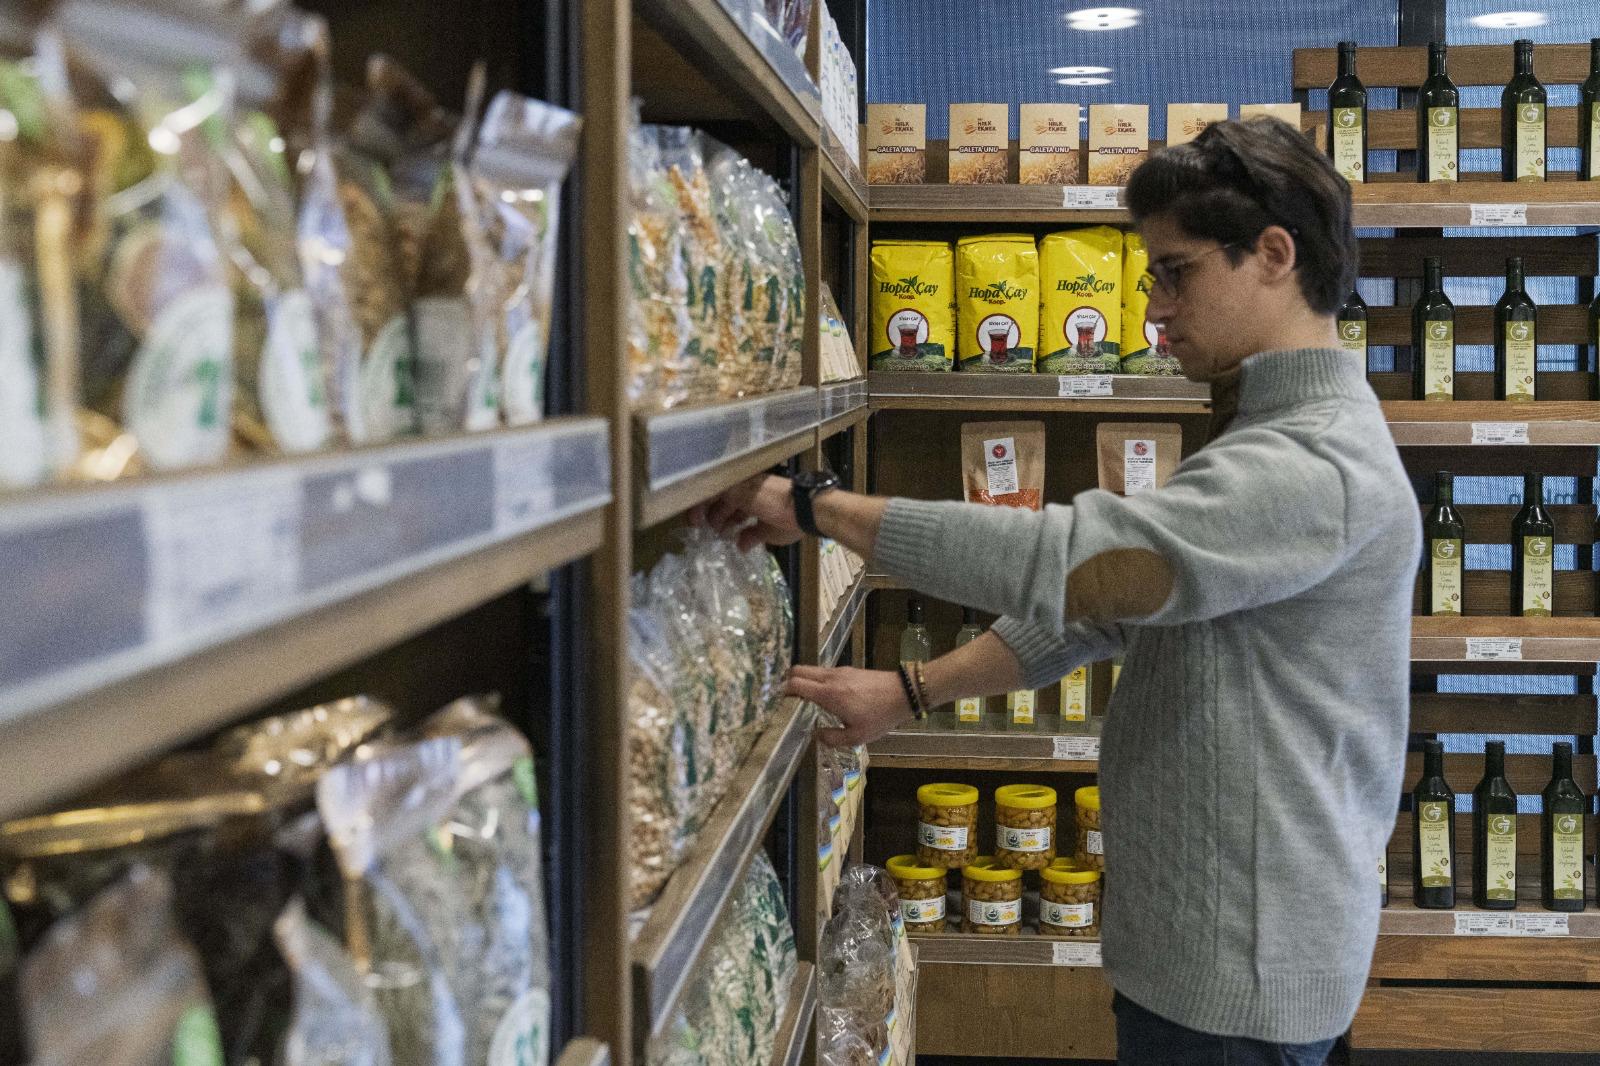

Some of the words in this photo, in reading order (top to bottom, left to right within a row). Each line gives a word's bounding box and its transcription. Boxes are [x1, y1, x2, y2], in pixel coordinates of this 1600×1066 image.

[880, 282, 910, 296] Hopa
[915, 281, 938, 296] Çay
[968, 287, 1000, 301] Hopa
[1005, 286, 1028, 300] Çay
[1056, 280, 1088, 294] Hopa
[1094, 279, 1115, 294] Çay
